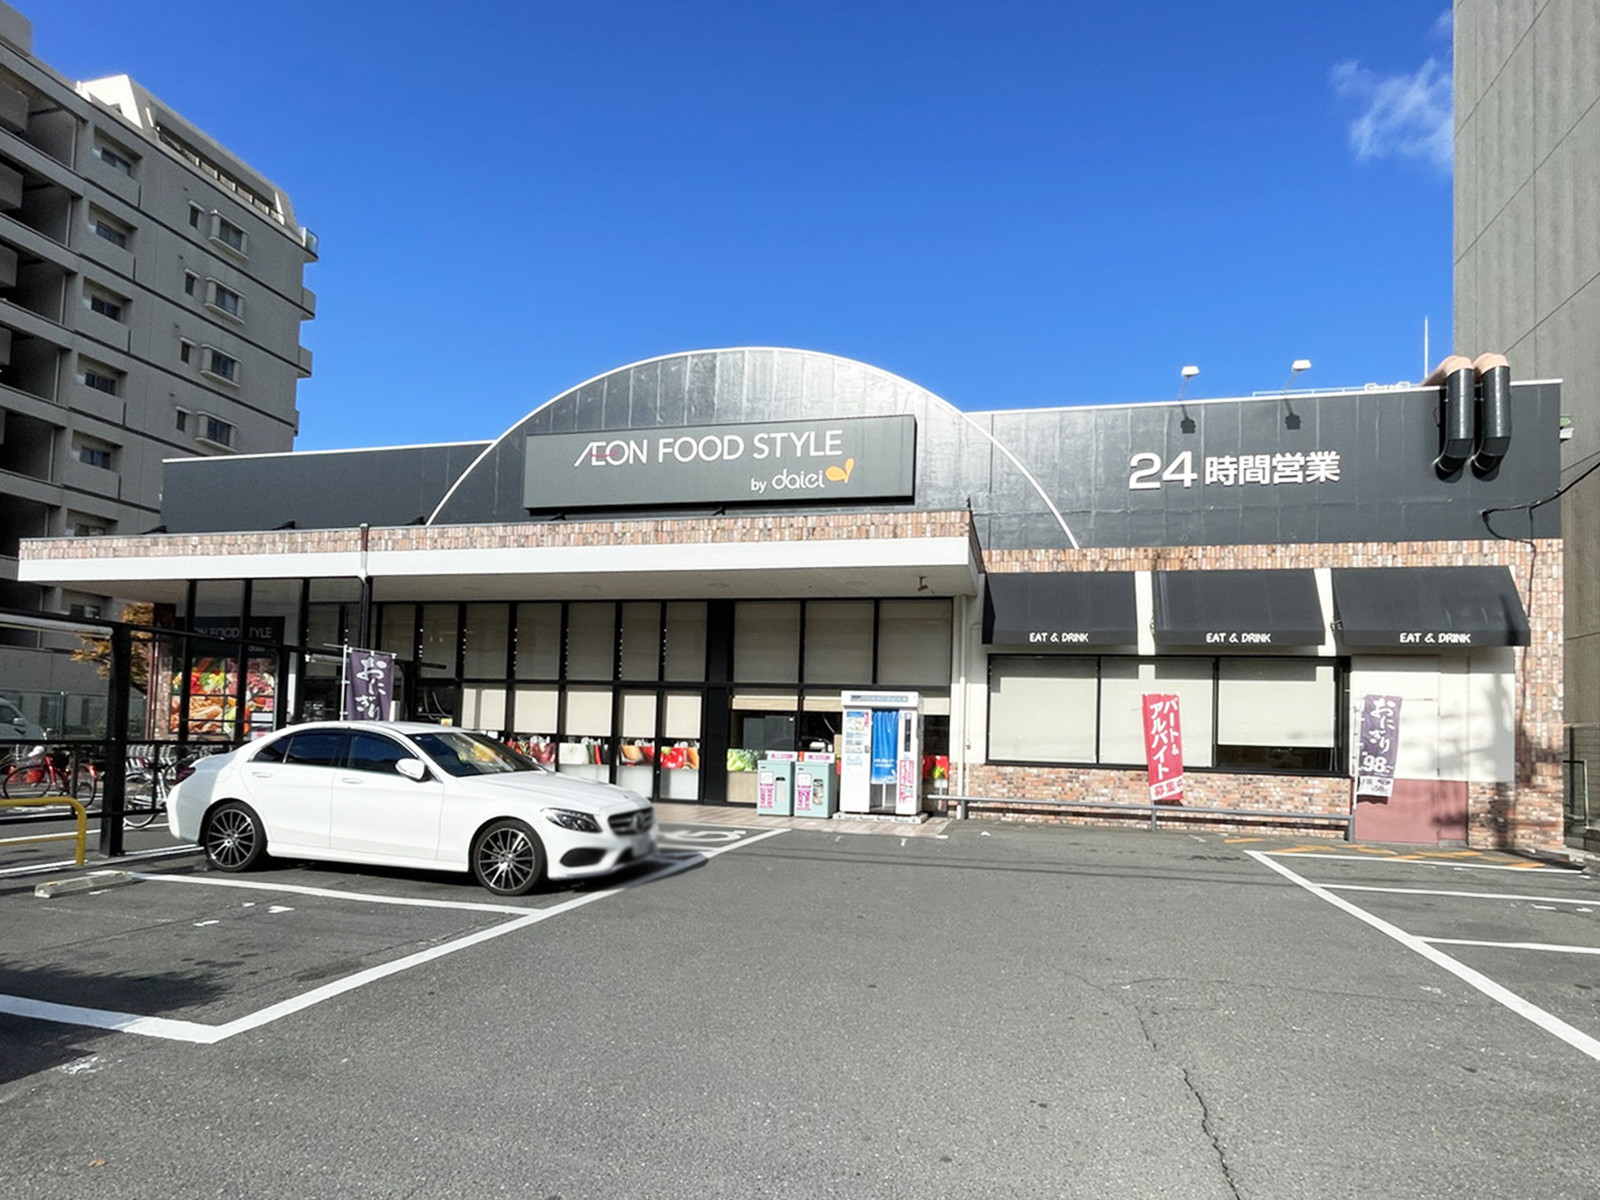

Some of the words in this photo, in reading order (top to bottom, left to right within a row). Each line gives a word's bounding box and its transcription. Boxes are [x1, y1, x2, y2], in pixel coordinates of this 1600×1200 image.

[658, 434, 744, 463] FOOD
[753, 430, 843, 458] STYLE
[751, 478, 767, 493] by
[772, 469, 825, 489] daiei
[1129, 450, 1198, 489] 24
[1204, 450, 1341, 486] 時間営業
[1029, 632, 1049, 643] EAT
[1050, 632, 1059, 643] &
[1061, 632, 1089, 643] DRINK
[1206, 632, 1227, 643] EAT
[1229, 632, 1239, 643] &
[1241, 632, 1271, 643] DRINK
[1400, 632, 1421, 643] EAT
[1425, 632, 1435, 643] &
[1438, 632, 1471, 643] DRINK
[355, 657, 387, 721] おにぎり
[1149, 701, 1170, 780] アルバイト
[1368, 698, 1396, 754] おにぎり
